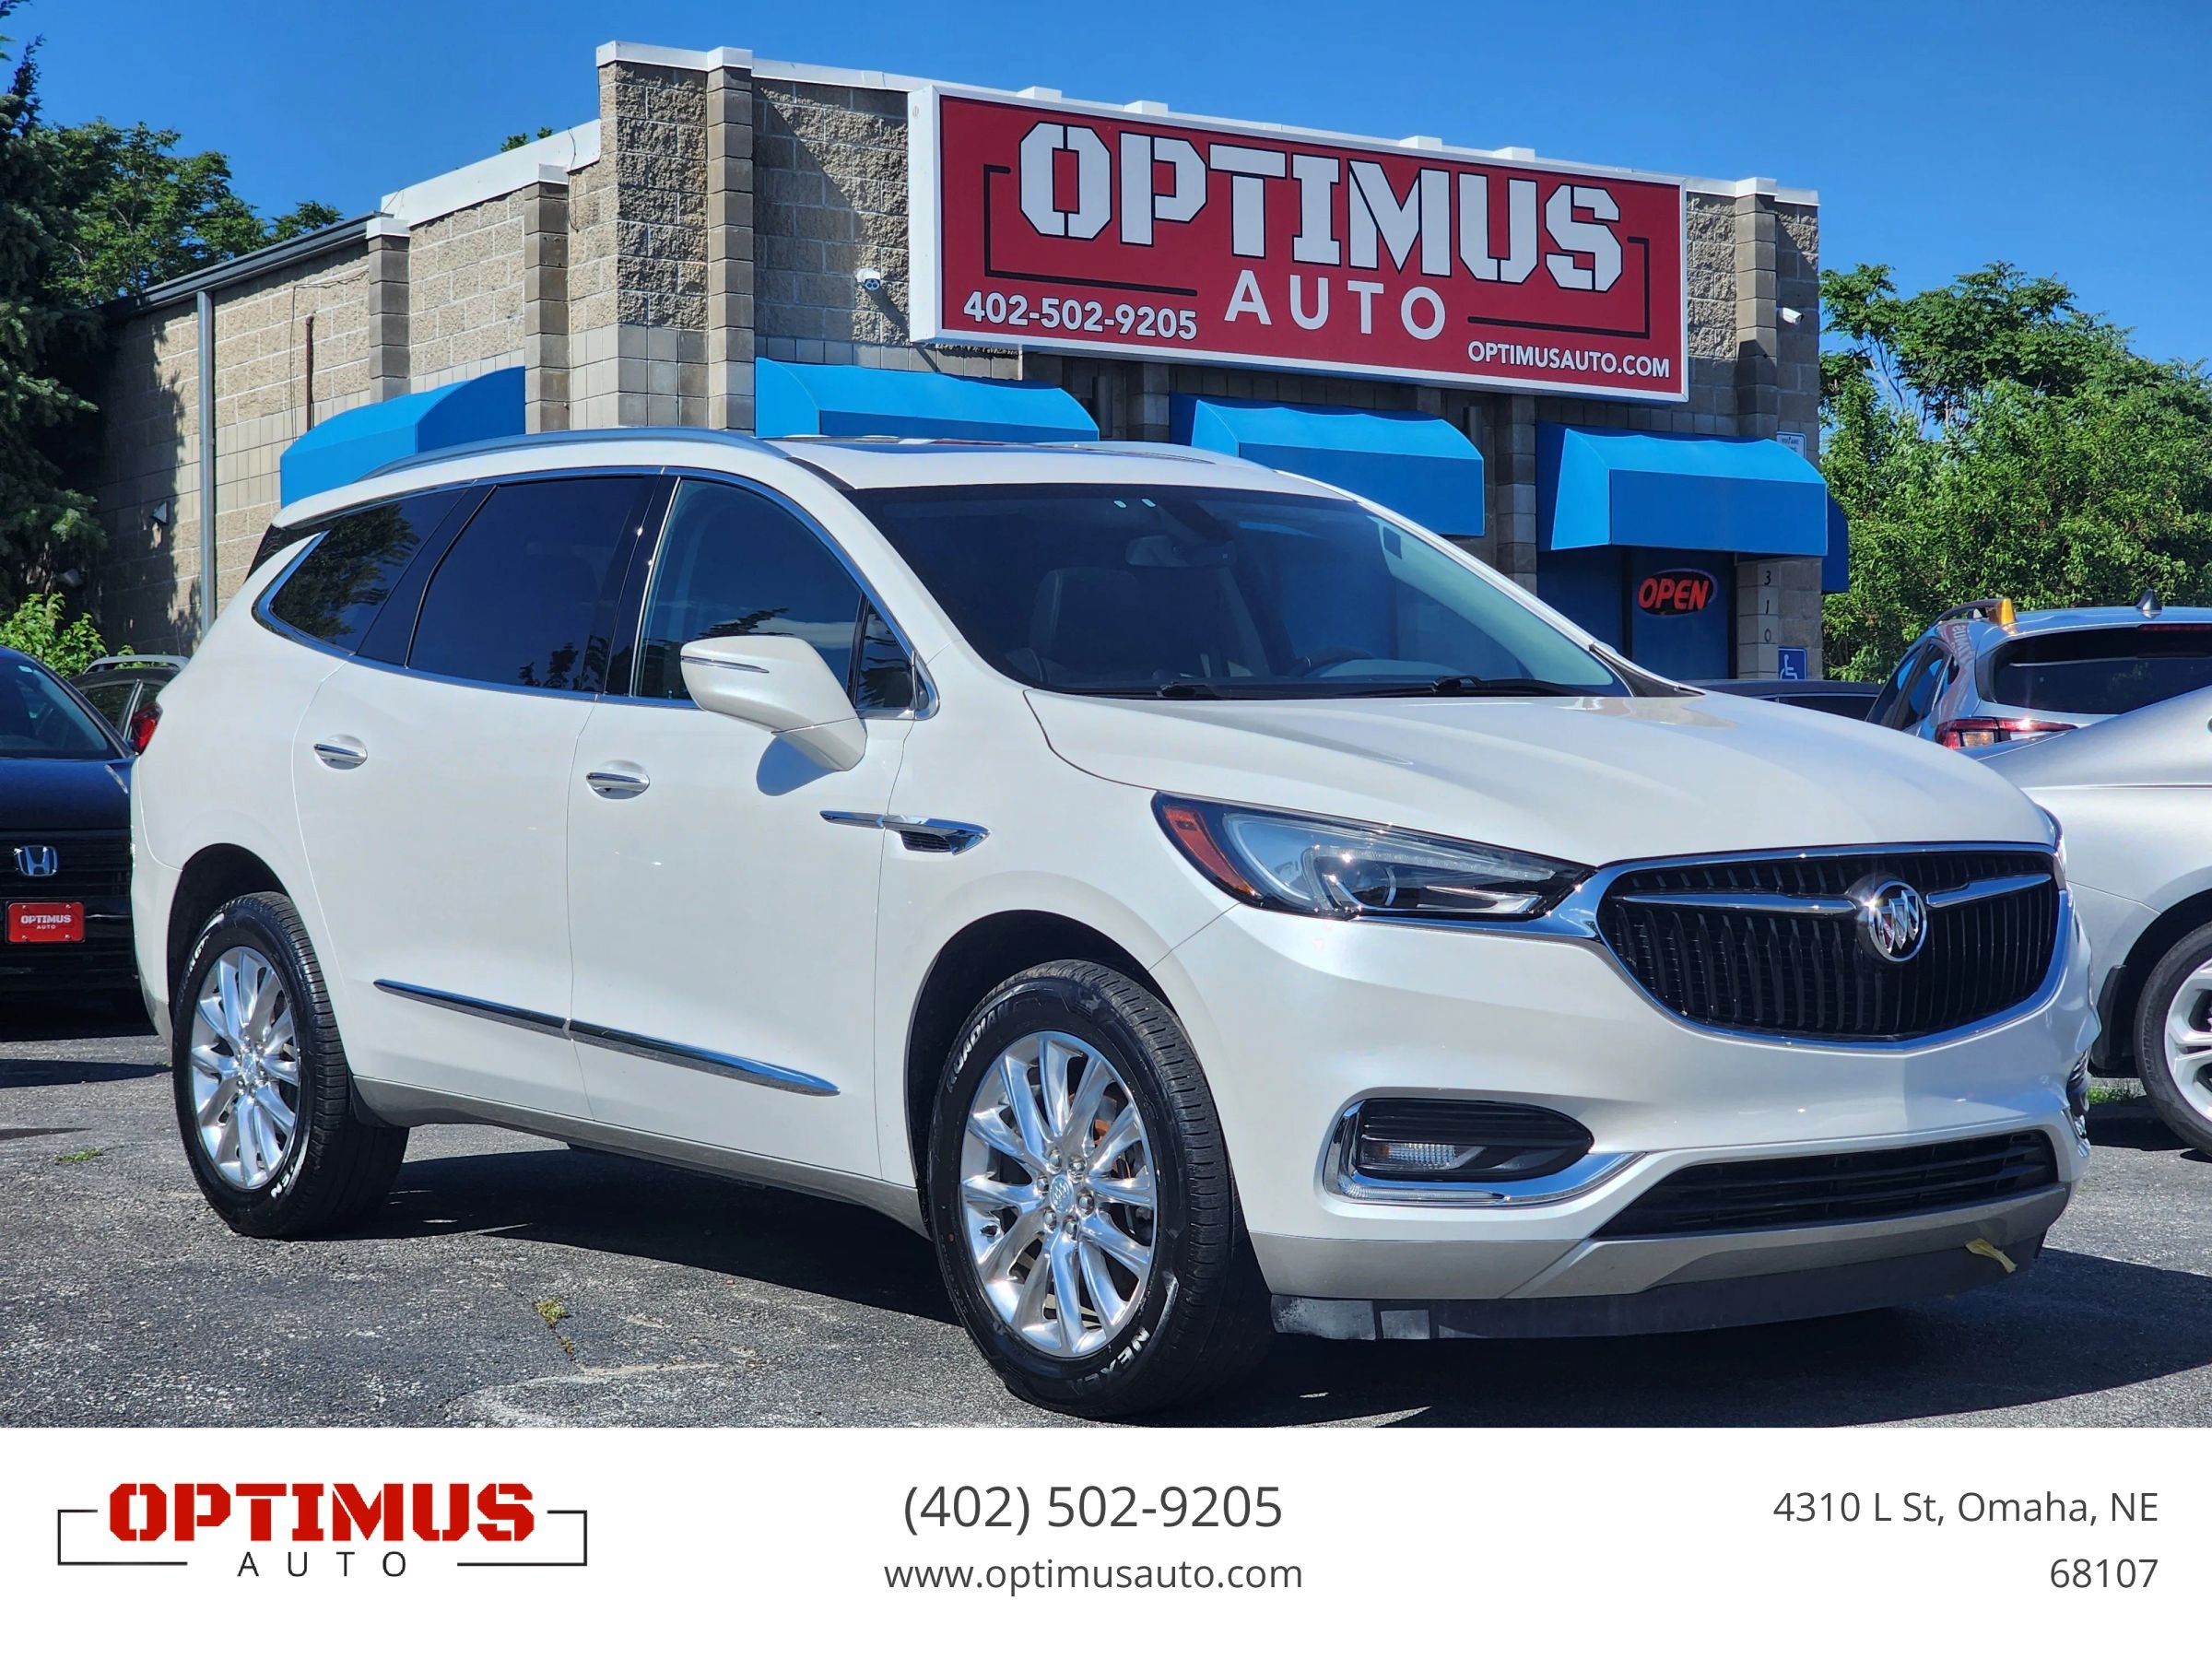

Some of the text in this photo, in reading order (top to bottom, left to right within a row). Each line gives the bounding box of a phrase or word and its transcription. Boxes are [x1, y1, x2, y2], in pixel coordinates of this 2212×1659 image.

[1019, 122, 1623, 293] OPTIMUS
[963, 290, 1198, 340] 402-502-9205
[1224, 269, 1446, 340] AUTO
[1467, 340, 1671, 378] OPTIMUSAUTO.COM
[1638, 577, 1710, 611] OPEN
[20, 914, 72, 924] OPTIMUS
